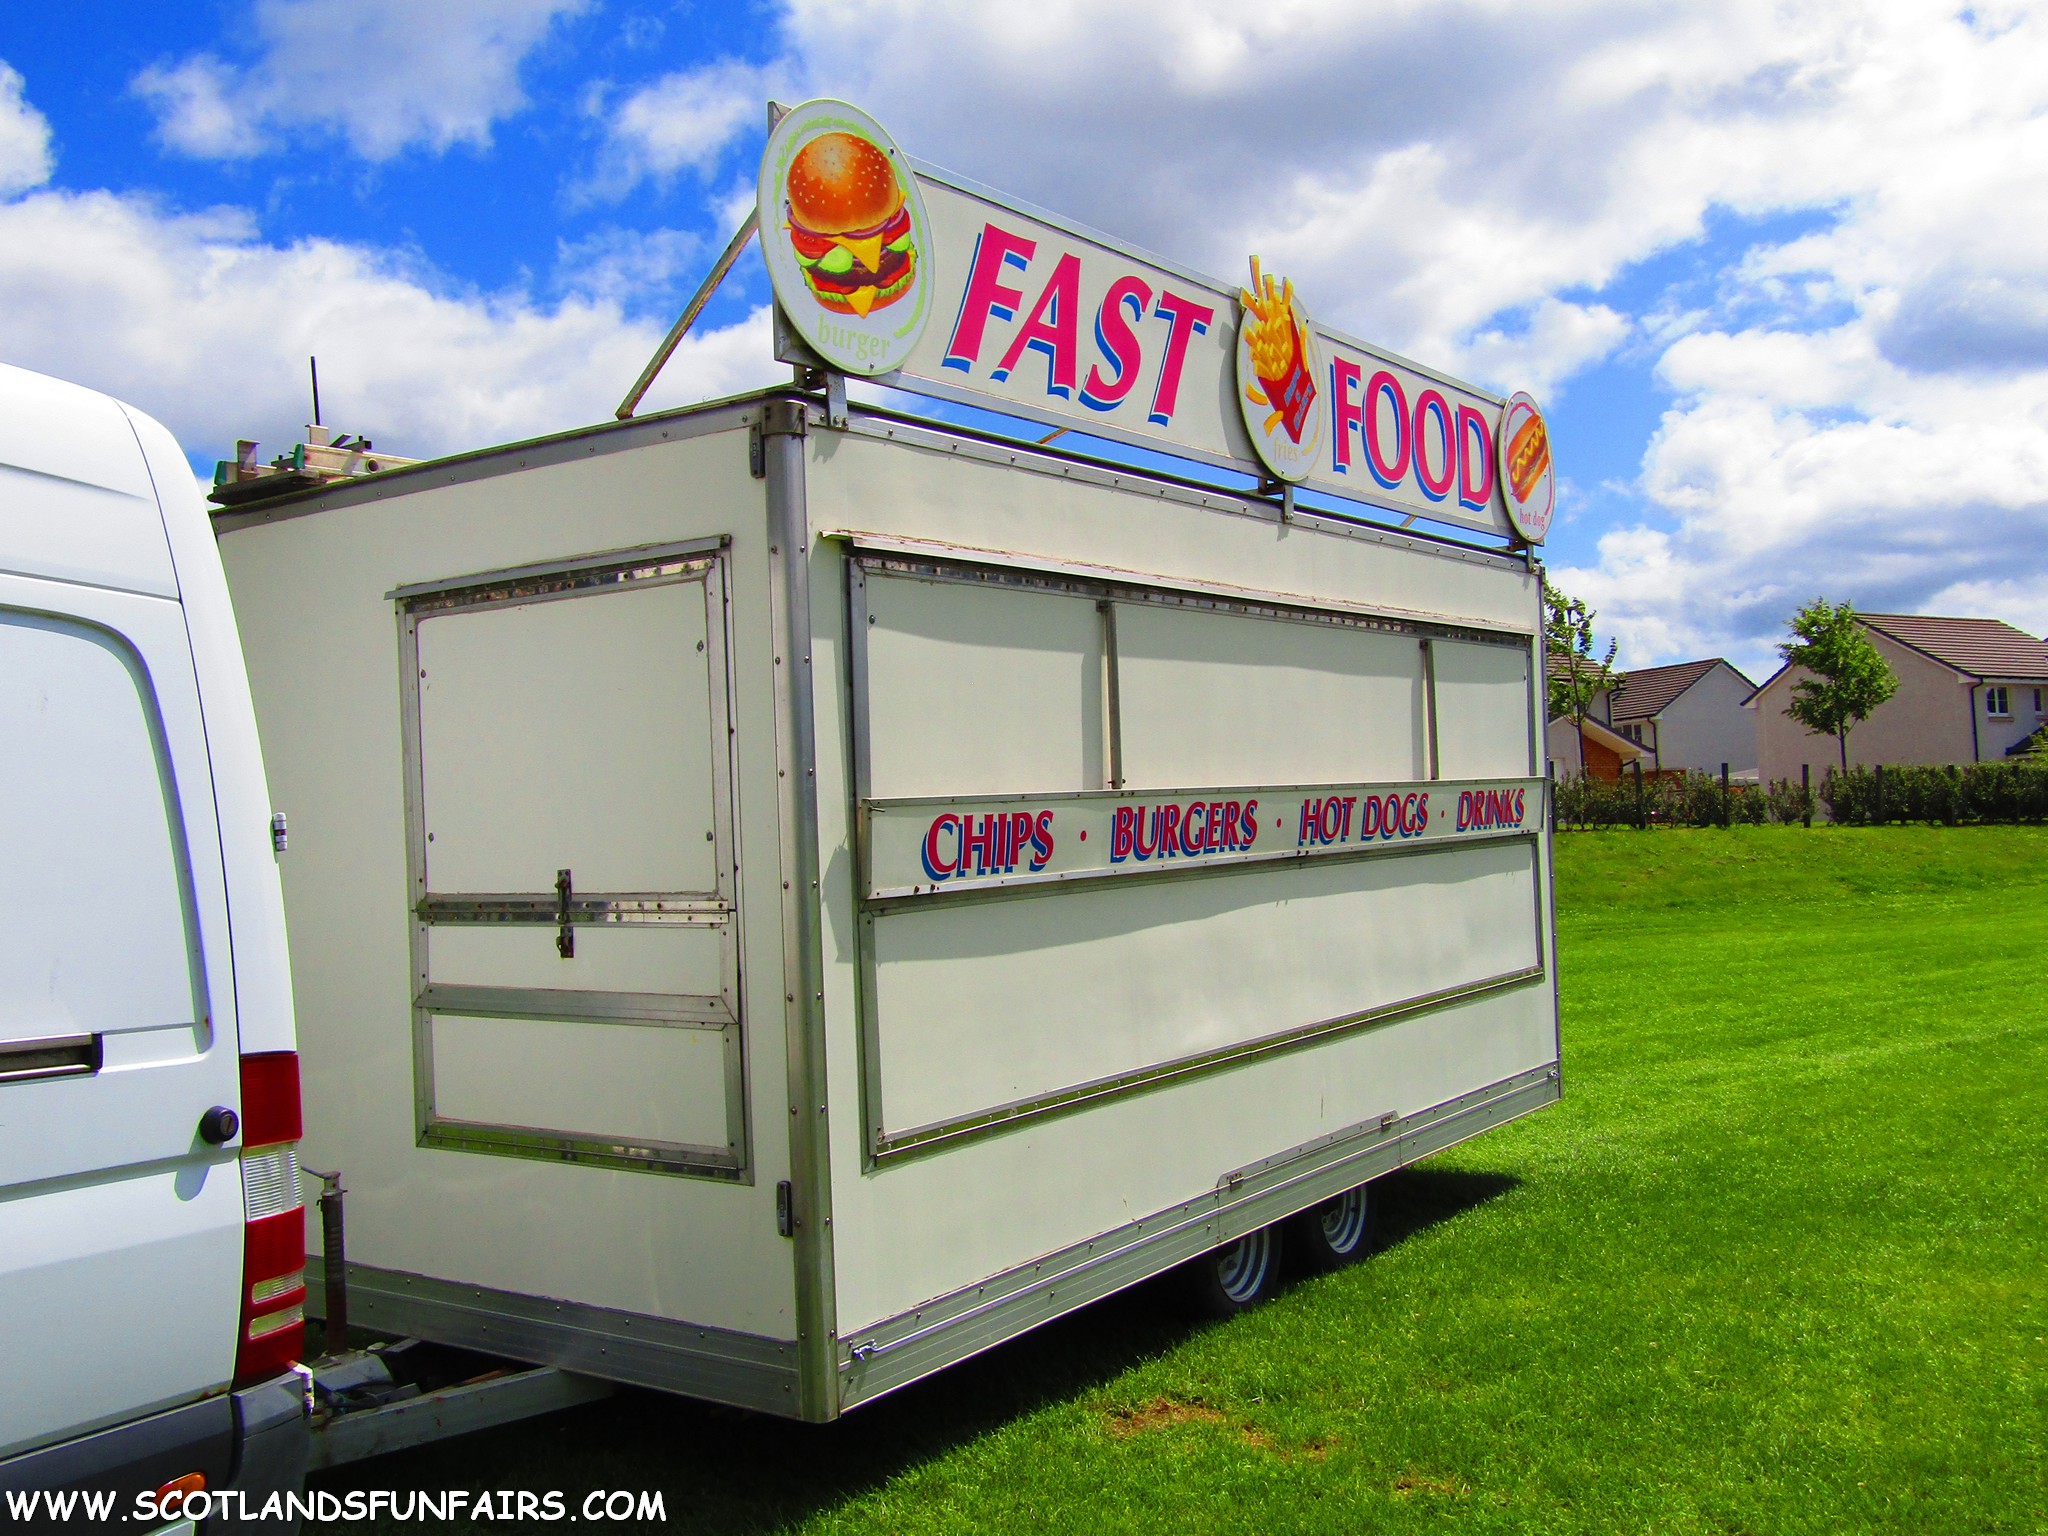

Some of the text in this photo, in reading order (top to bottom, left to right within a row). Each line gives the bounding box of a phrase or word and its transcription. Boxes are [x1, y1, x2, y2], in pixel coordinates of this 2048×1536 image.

[817, 313, 891, 359] burger
[941, 222, 1493, 512] FAST FOOD
[1273, 437, 1299, 463] fries
[1519, 507, 1545, 530] hot dog
[921, 787, 1526, 881] CHIPS BURGERS HOT DOGS DRINKS
